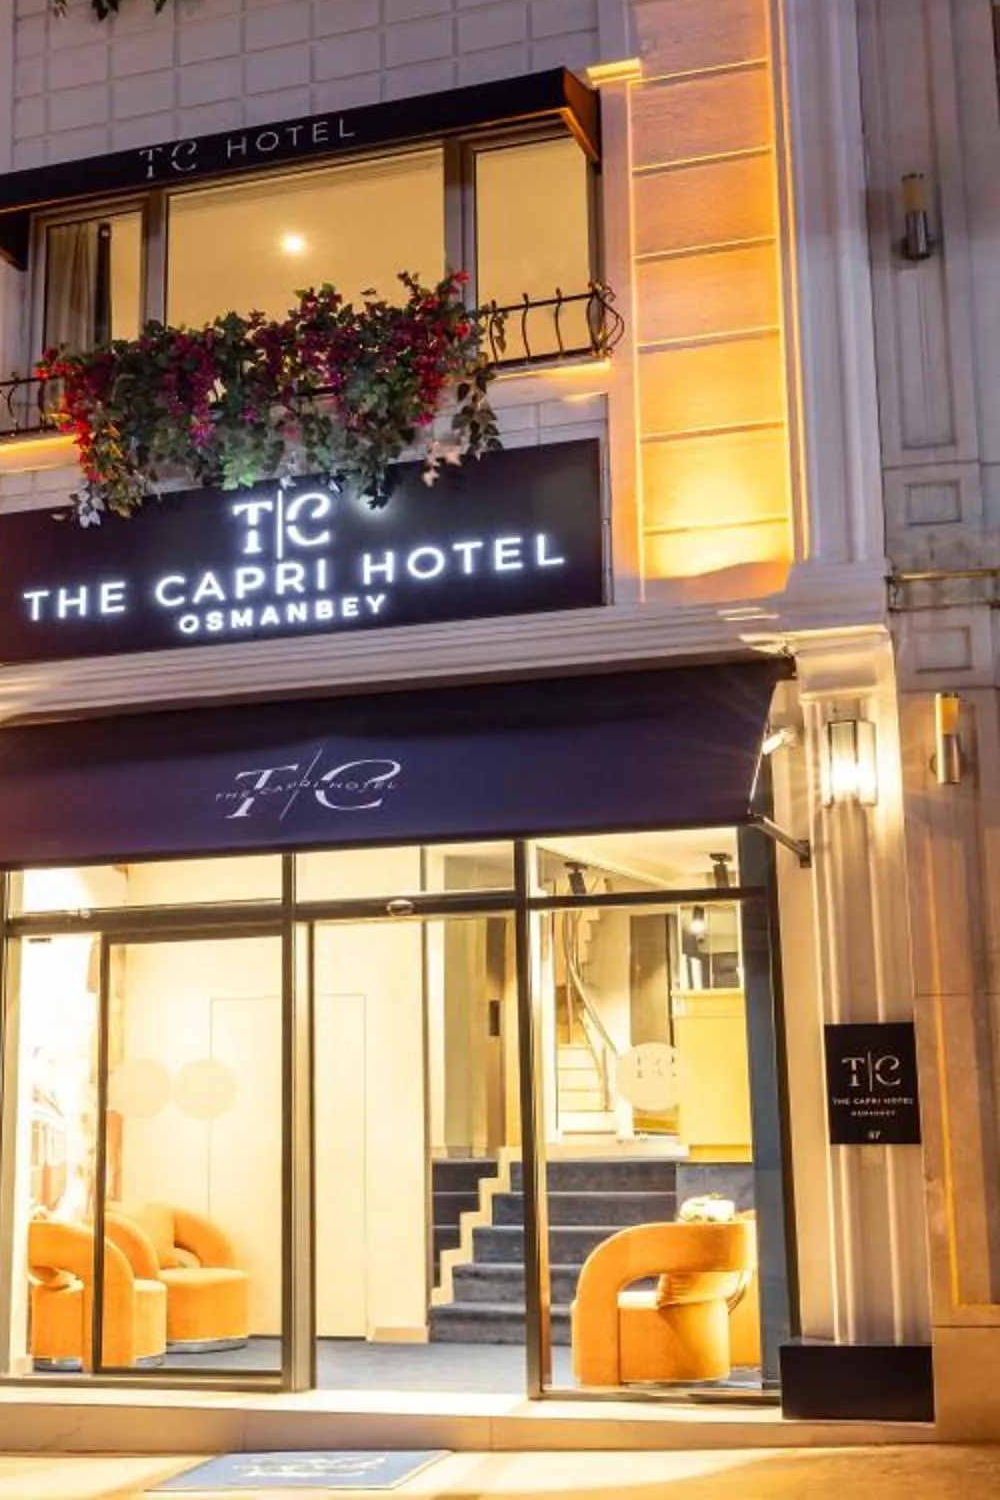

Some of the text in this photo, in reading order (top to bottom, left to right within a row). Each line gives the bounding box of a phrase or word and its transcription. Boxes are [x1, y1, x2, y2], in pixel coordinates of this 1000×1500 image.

[226, 118, 356, 159] HOTEL
[23, 532, 566, 622] THE CAPRI HOTEL
[178, 593, 386, 634] OSMANBEY
[853, 1097, 882, 1106] CAPRI
